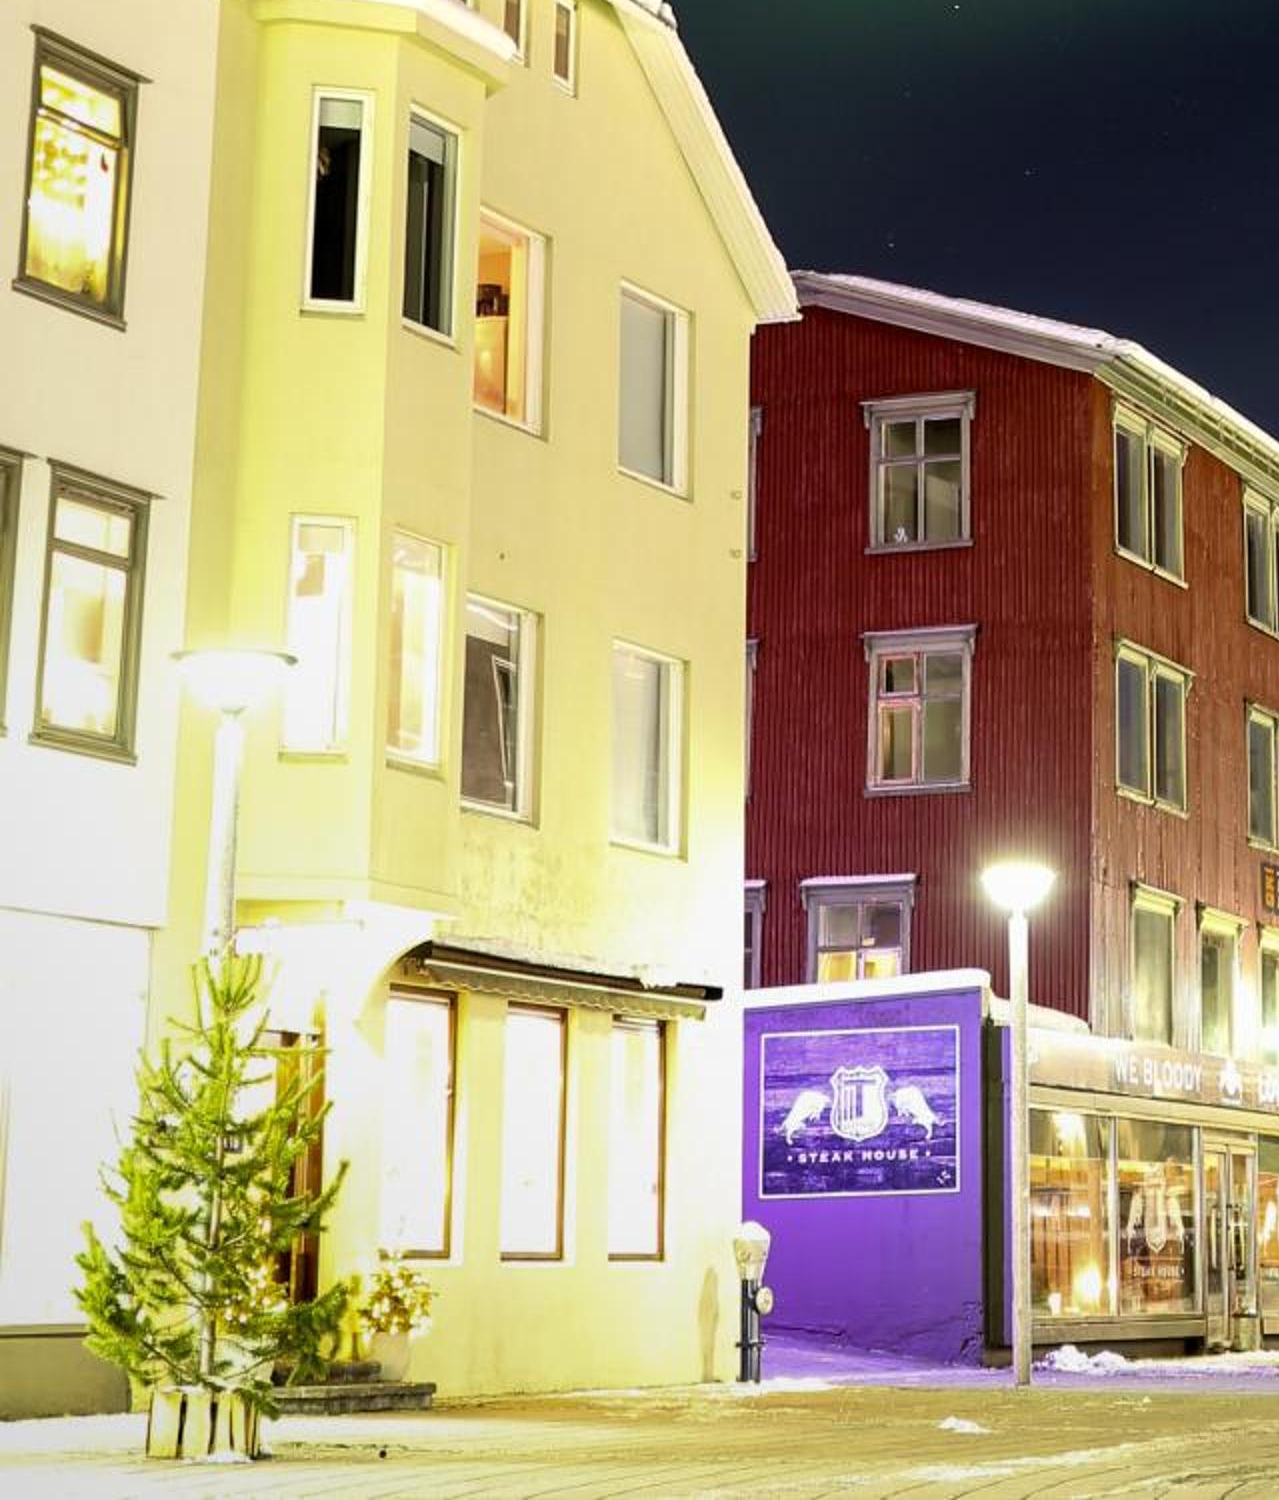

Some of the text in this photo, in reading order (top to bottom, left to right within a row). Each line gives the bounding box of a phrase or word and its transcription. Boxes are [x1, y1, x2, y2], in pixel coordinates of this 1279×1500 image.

[1115, 1052, 1138, 1084] WE
[1143, 1058, 1202, 1091] BLOODY
[798, 1149, 919, 1164] STEAK HOUSE
